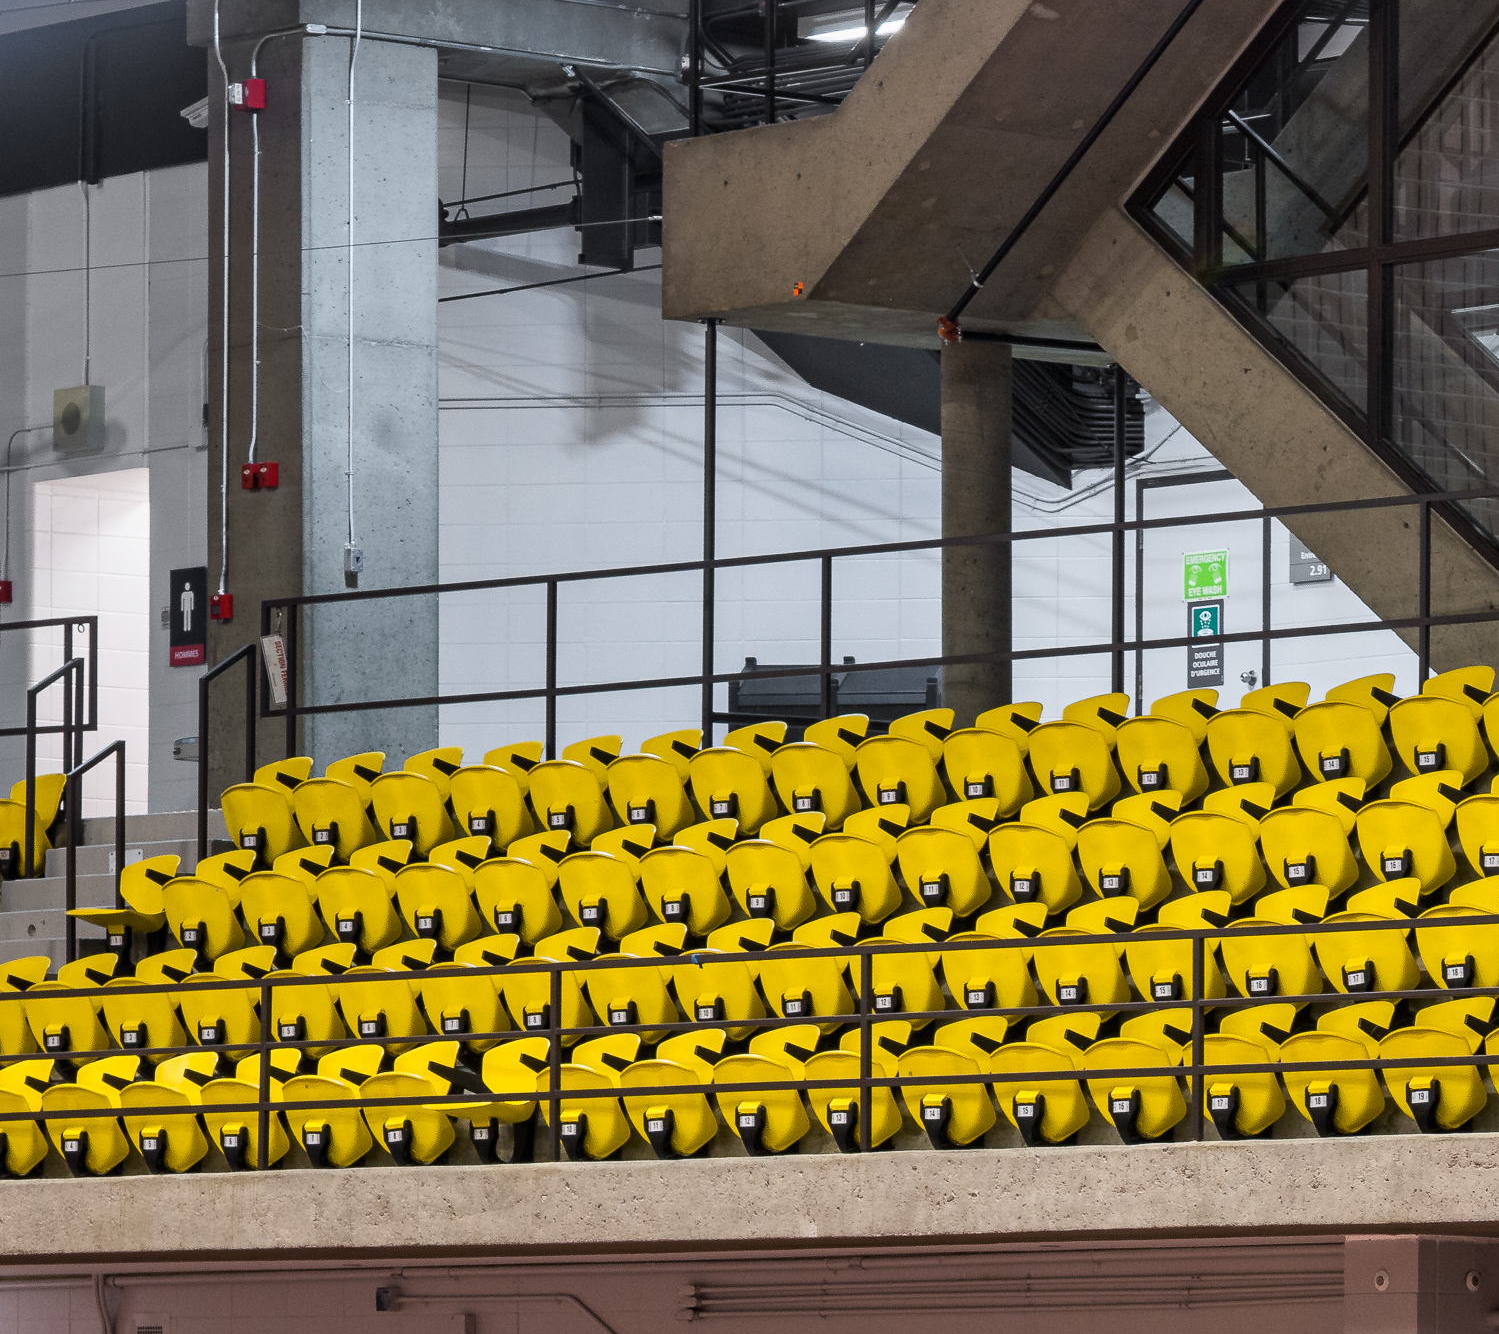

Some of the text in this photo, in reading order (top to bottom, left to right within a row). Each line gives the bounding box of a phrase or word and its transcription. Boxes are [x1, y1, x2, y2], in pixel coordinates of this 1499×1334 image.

[1185, 552, 1226, 565] EMERGENCY
[1309, 564, 1327, 576] 2.91
[1188, 585, 1222, 597] EYE WASH
[175, 649, 199, 660] HOMMES
[275, 641, 286, 669] SECTION
[1195, 650, 1216, 660] DOUCHE
[1193, 659, 1218, 669] OCULAIRE
[1191, 668, 1220, 678] D'URGENCE
[1423, 755, 1430, 763] 15
[1328, 760, 1335, 768] 14
[1237, 768, 1244, 776] 13
[1058, 779, 1065, 787] 11
[1146, 774, 1153, 783] 12
[971, 785, 979, 794] 10
[1488, 856, 1496, 865] 17
[1390, 861, 1397, 870] 16
[1293, 866, 1300, 875] 15
[1201, 872, 1208, 880] 14
[1018, 881, 1025, 890] 12
[1107, 878, 1114, 887] 13
[928, 885, 934, 893] 11
[1451, 968, 1459, 977] 18
[1352, 974, 1360, 983] 17
[1255, 980, 1263, 989] 16
[1065, 989, 1072, 997] 14
[1159, 986, 1166, 995] 15
[973, 992, 980, 1001] 13
[1314, 1096, 1322, 1105] 18
[1417, 1091, 1425, 1101] 19
[1117, 1102, 1125, 1111] 16
[1217, 1099, 1223, 1107] 17
[928, 1109, 936, 1117] 14
[1023, 1106, 1029, 1115] 15
